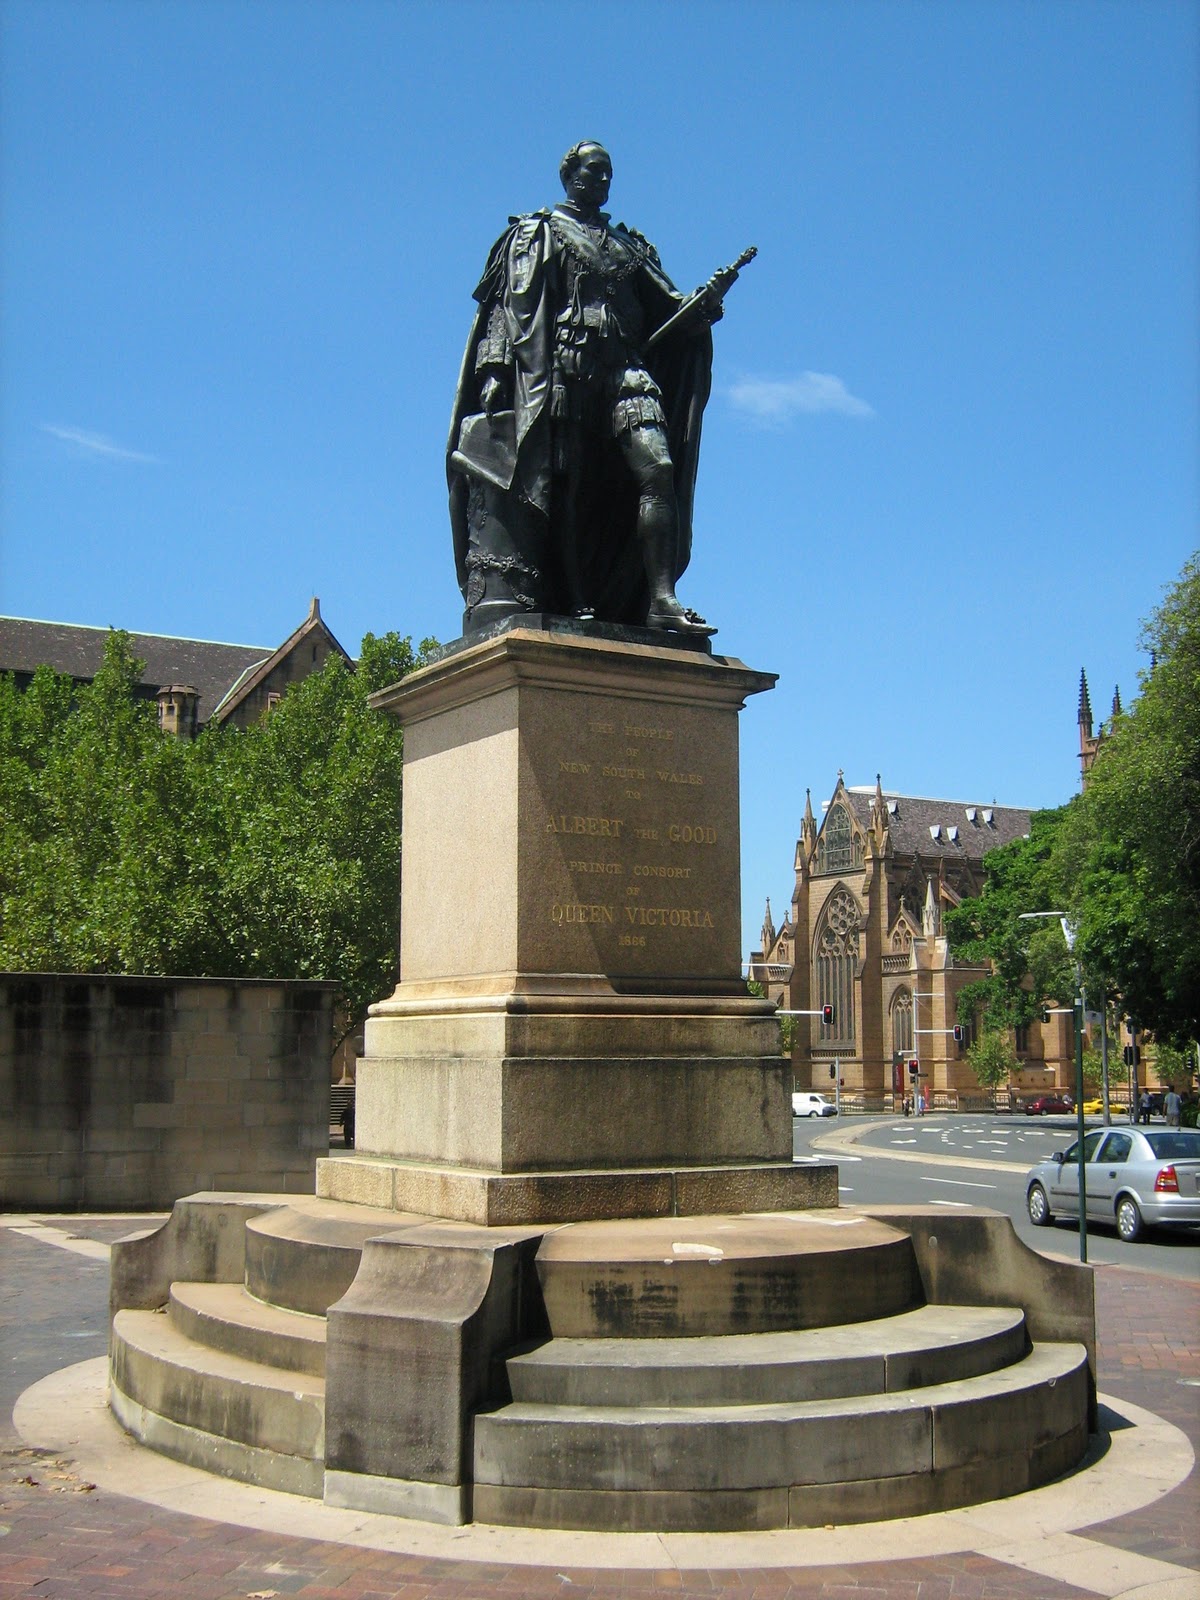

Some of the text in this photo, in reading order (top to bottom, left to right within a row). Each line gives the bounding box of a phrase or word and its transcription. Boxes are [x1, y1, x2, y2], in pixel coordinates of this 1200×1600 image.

[589, 722, 674, 741] THE PEOPLE
[626, 748, 640, 757] OF
[559, 761, 703, 785] NEW SOUTH WALES
[626, 790, 641, 800] TO
[545, 815, 718, 845] ALBERT THE GOOD
[568, 861, 692, 878] PRINCE CONSORT
[626, 887, 640, 896] OF
[552, 903, 715, 928] QUEEN VICTORIA
[618, 936, 646, 947] 1866
